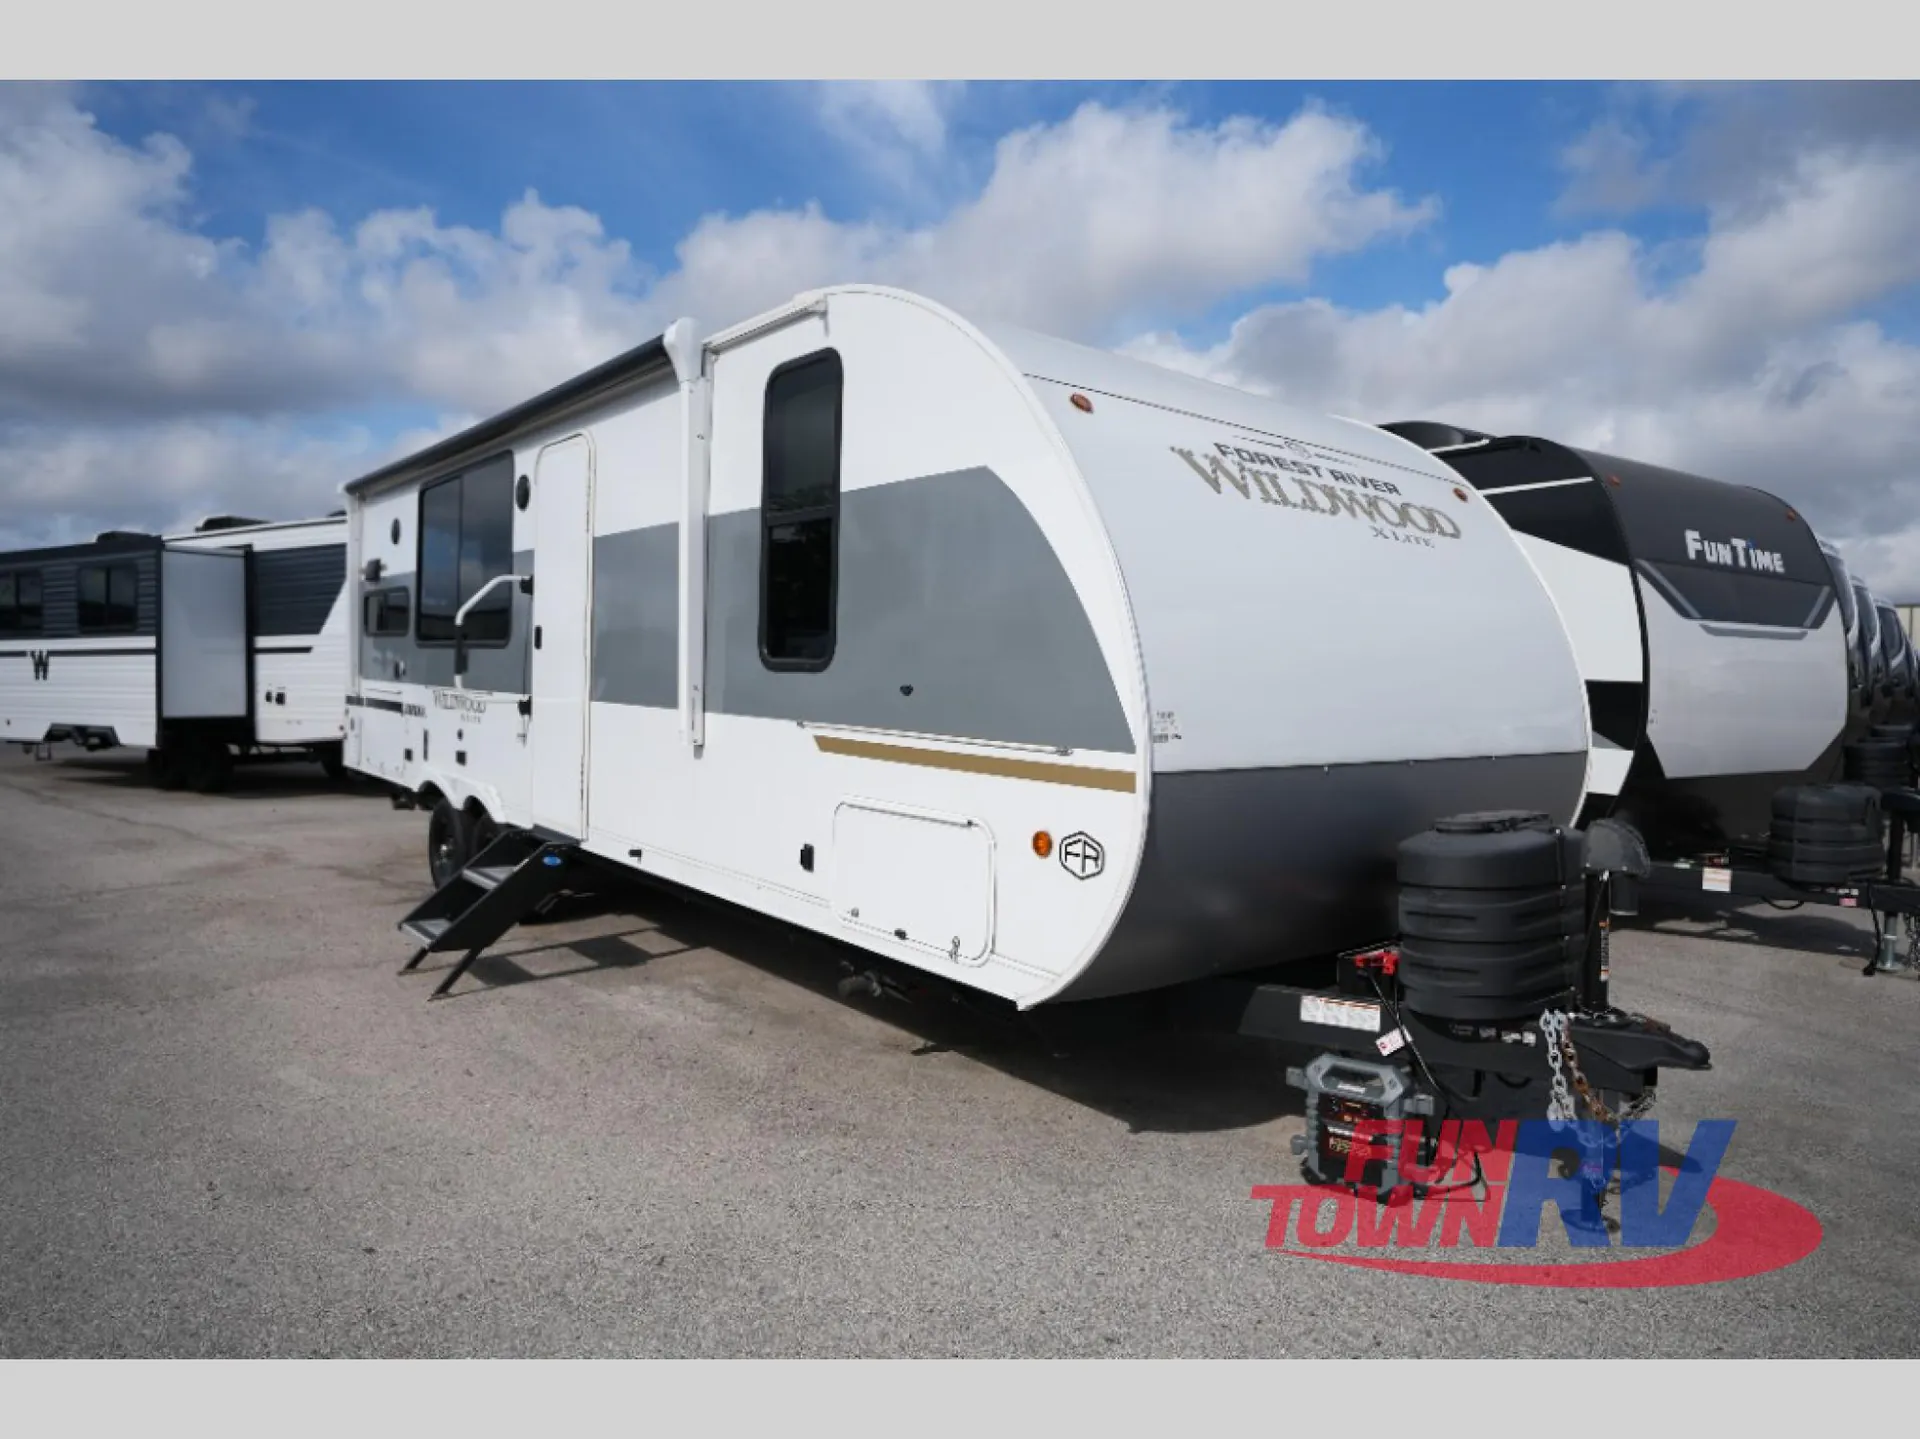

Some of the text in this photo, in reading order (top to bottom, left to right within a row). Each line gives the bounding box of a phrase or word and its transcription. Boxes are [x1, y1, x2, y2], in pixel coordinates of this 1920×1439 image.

[1169, 446, 1462, 539] WILDWOOD
[1213, 442, 1402, 496] FOREST RIVER
